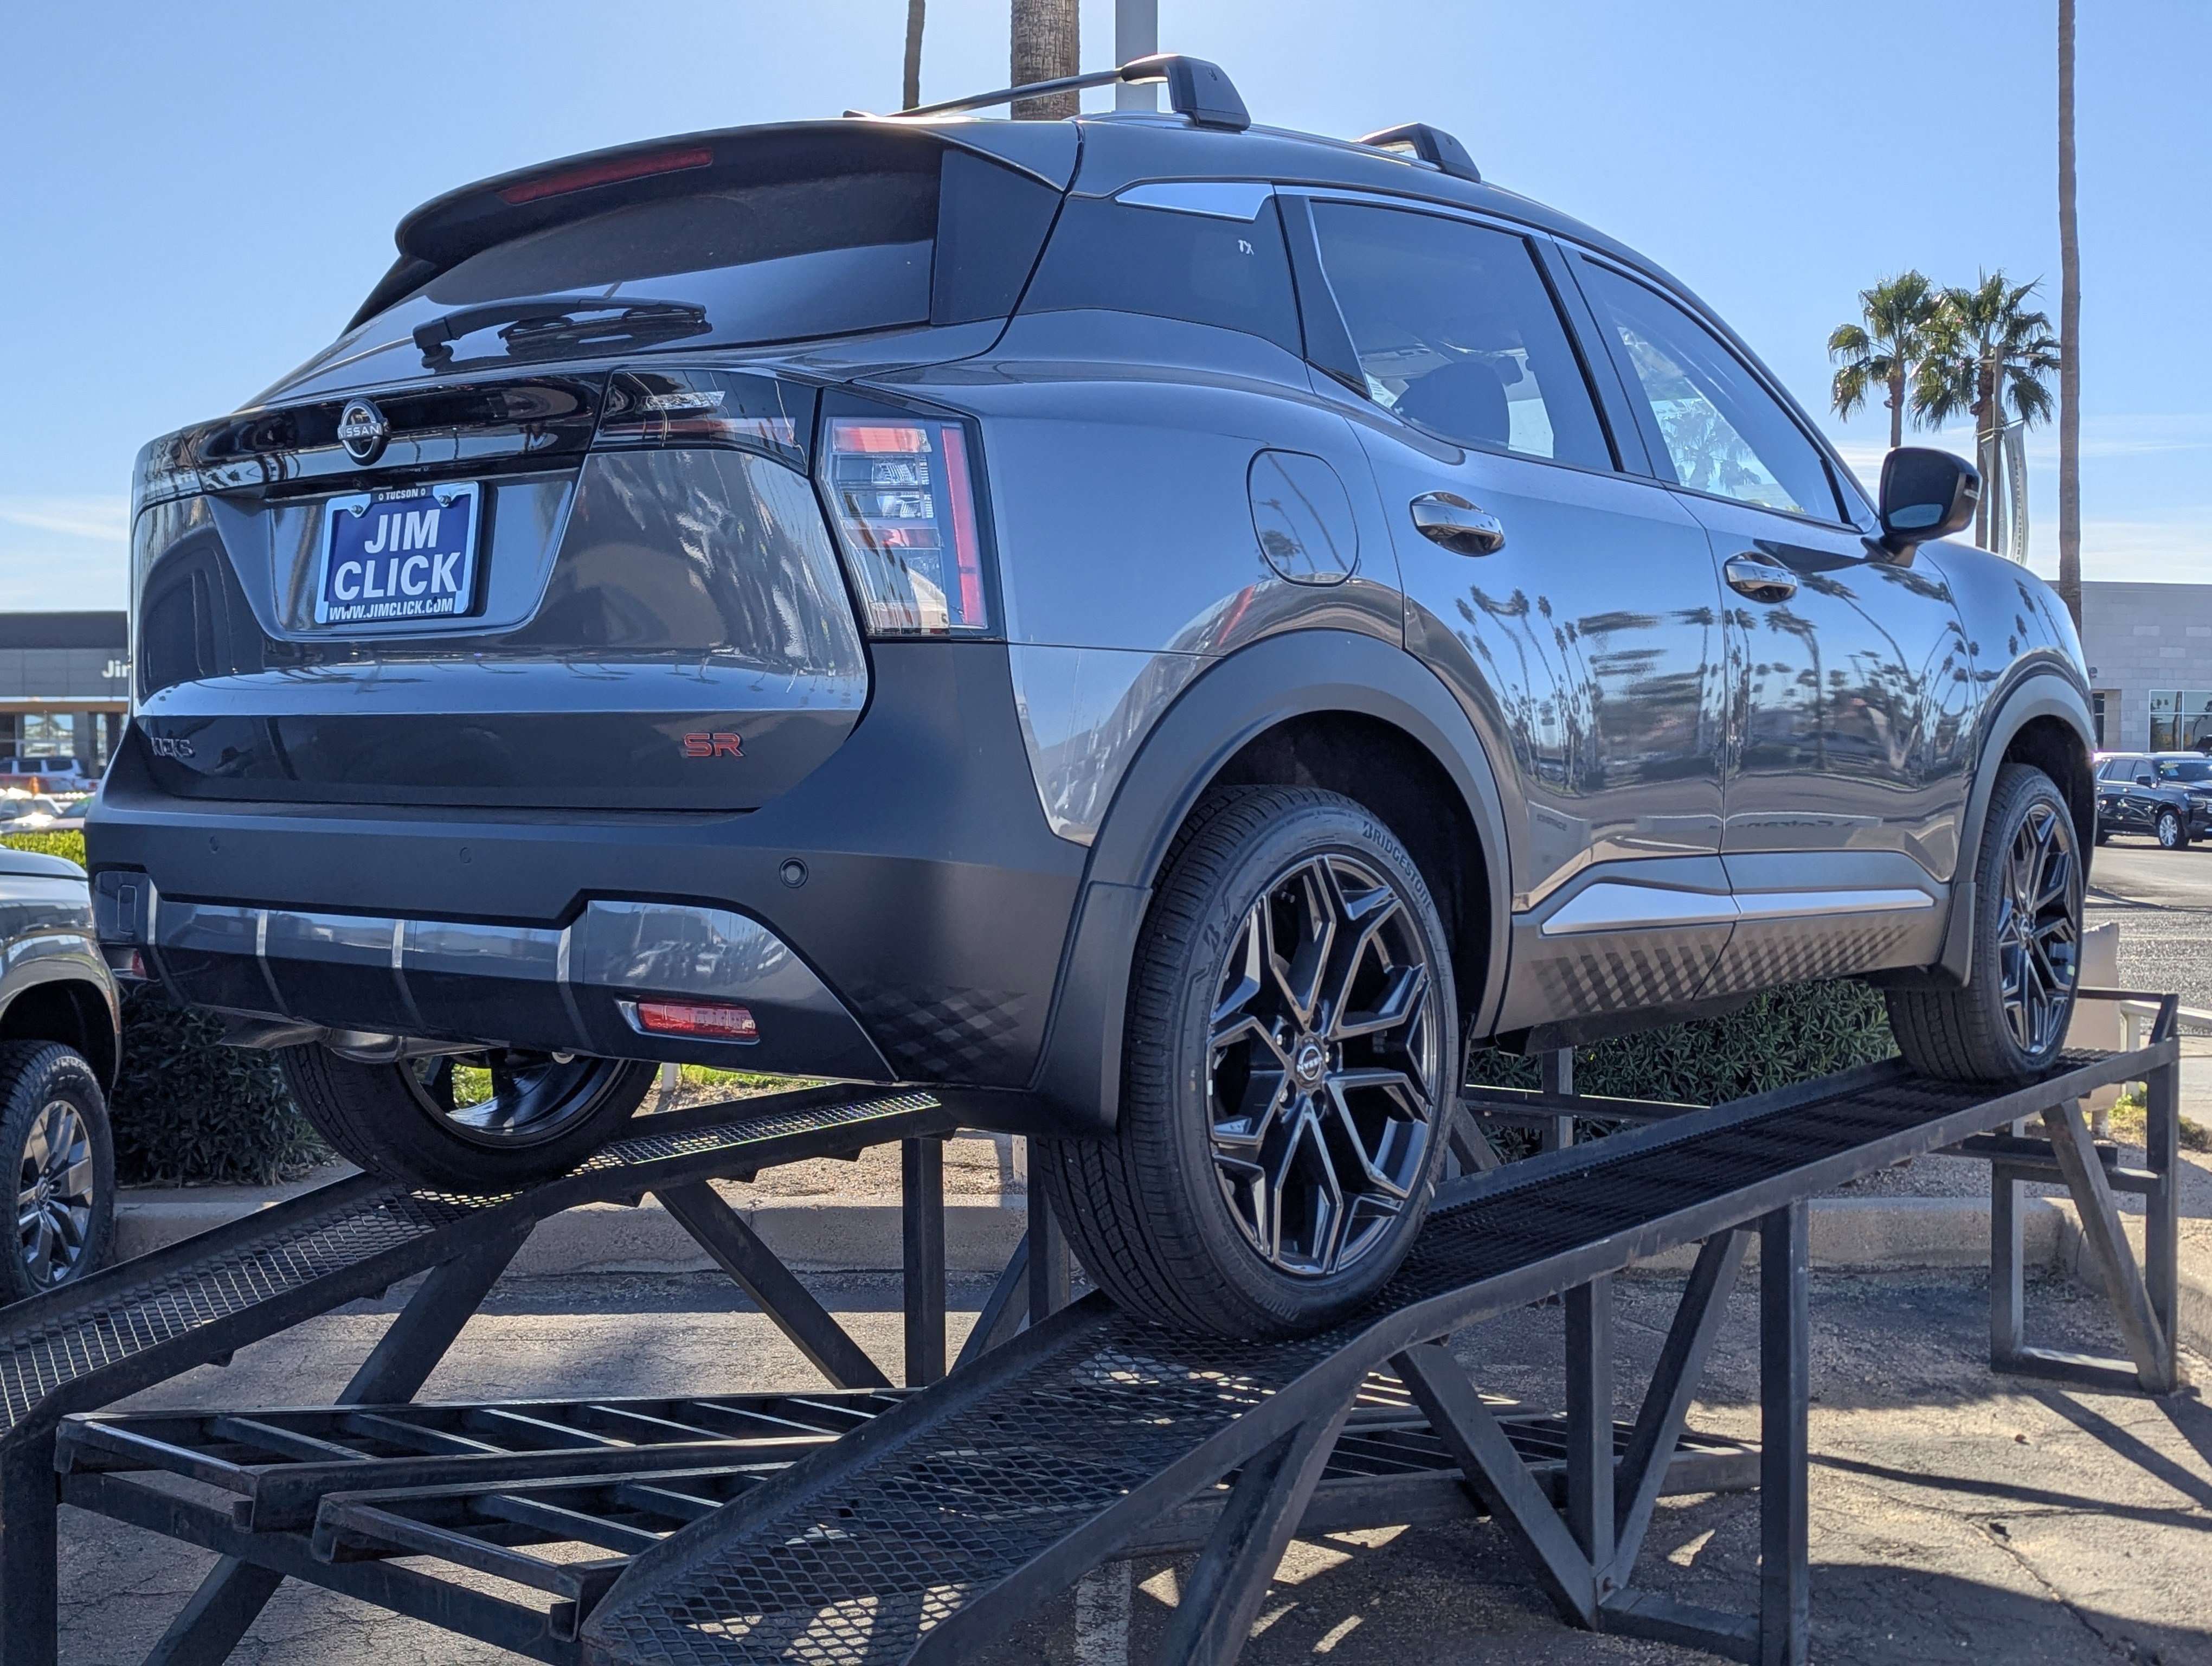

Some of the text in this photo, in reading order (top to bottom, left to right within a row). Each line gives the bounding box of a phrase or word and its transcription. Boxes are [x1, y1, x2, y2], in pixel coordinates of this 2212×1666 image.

[339, 425, 380, 438] NISSAN
[385, 488, 419, 500] TUCSON
[364, 509, 441, 554] JIM
[334, 552, 461, 601] CLICK
[329, 598, 454, 621] WWW.JIMCLICK.COM
[684, 732, 744, 757] SR
[1362, 820, 1433, 914] BRIDGESTONE
